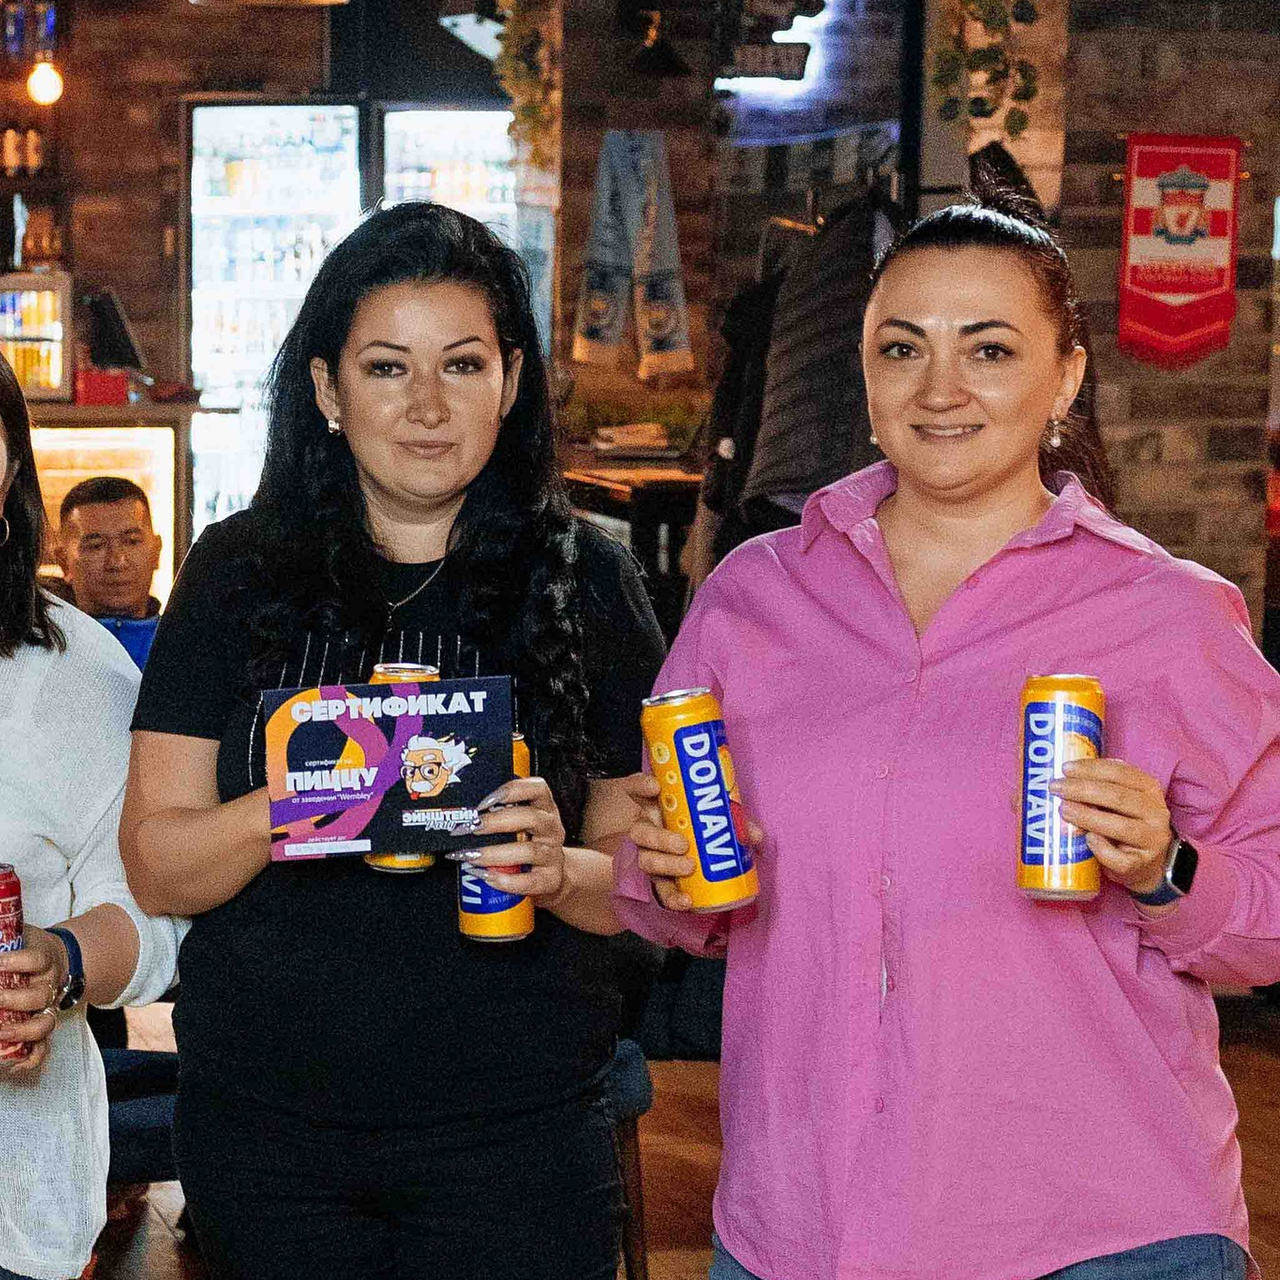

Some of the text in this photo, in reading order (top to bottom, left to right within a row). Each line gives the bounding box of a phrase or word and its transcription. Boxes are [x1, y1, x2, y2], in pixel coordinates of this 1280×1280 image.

[290, 692, 487, 723] СЕРТИФИКАТ
[285, 767, 378, 792] ПИЦЦУ
[682, 732, 737, 872] DONAVI
[1025, 712, 1056, 856] DONAVI
